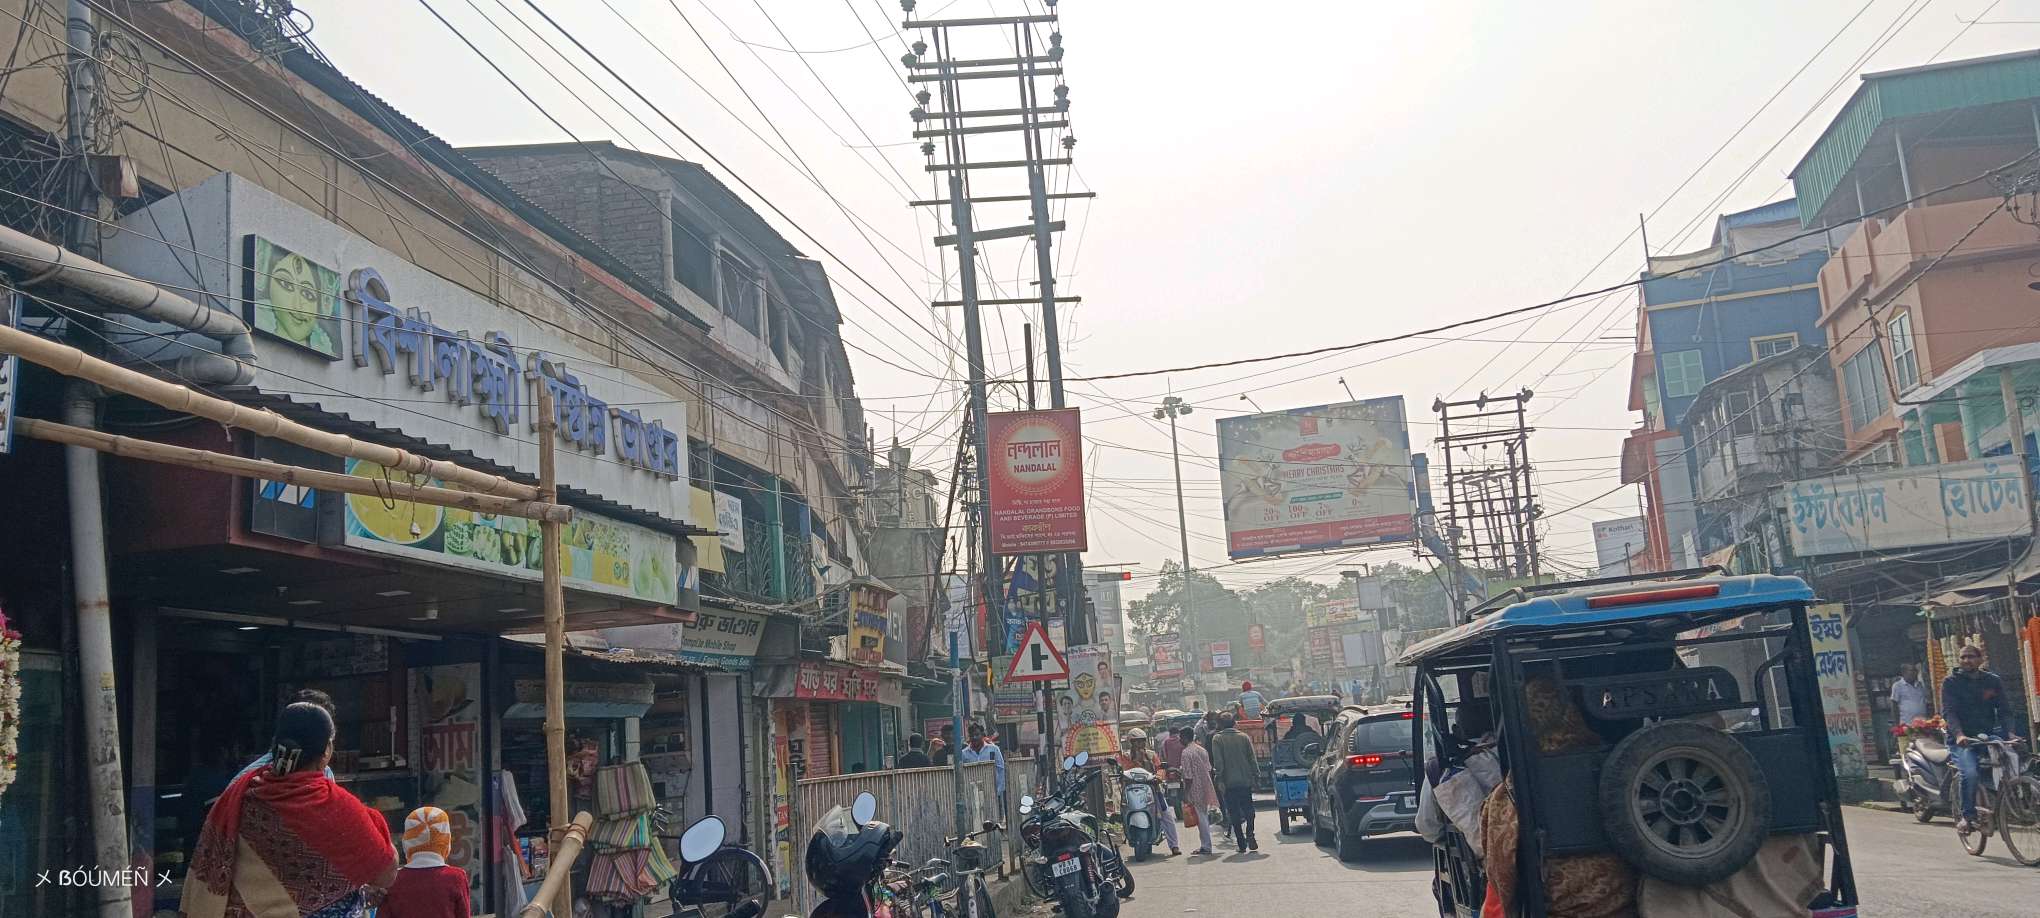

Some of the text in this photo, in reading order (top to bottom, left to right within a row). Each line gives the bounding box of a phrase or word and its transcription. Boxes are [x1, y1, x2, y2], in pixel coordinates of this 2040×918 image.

[344, 267, 521, 436] বিশালাক্ষী
[1007, 440, 1062, 459] নন্দলাল
[1014, 463, 1057, 474] NANDALAL
[1306, 464, 1344, 477] CHRISTMAS
[1939, 462, 2024, 517] হোটেল
[1601, 678, 1723, 709] APSARA
